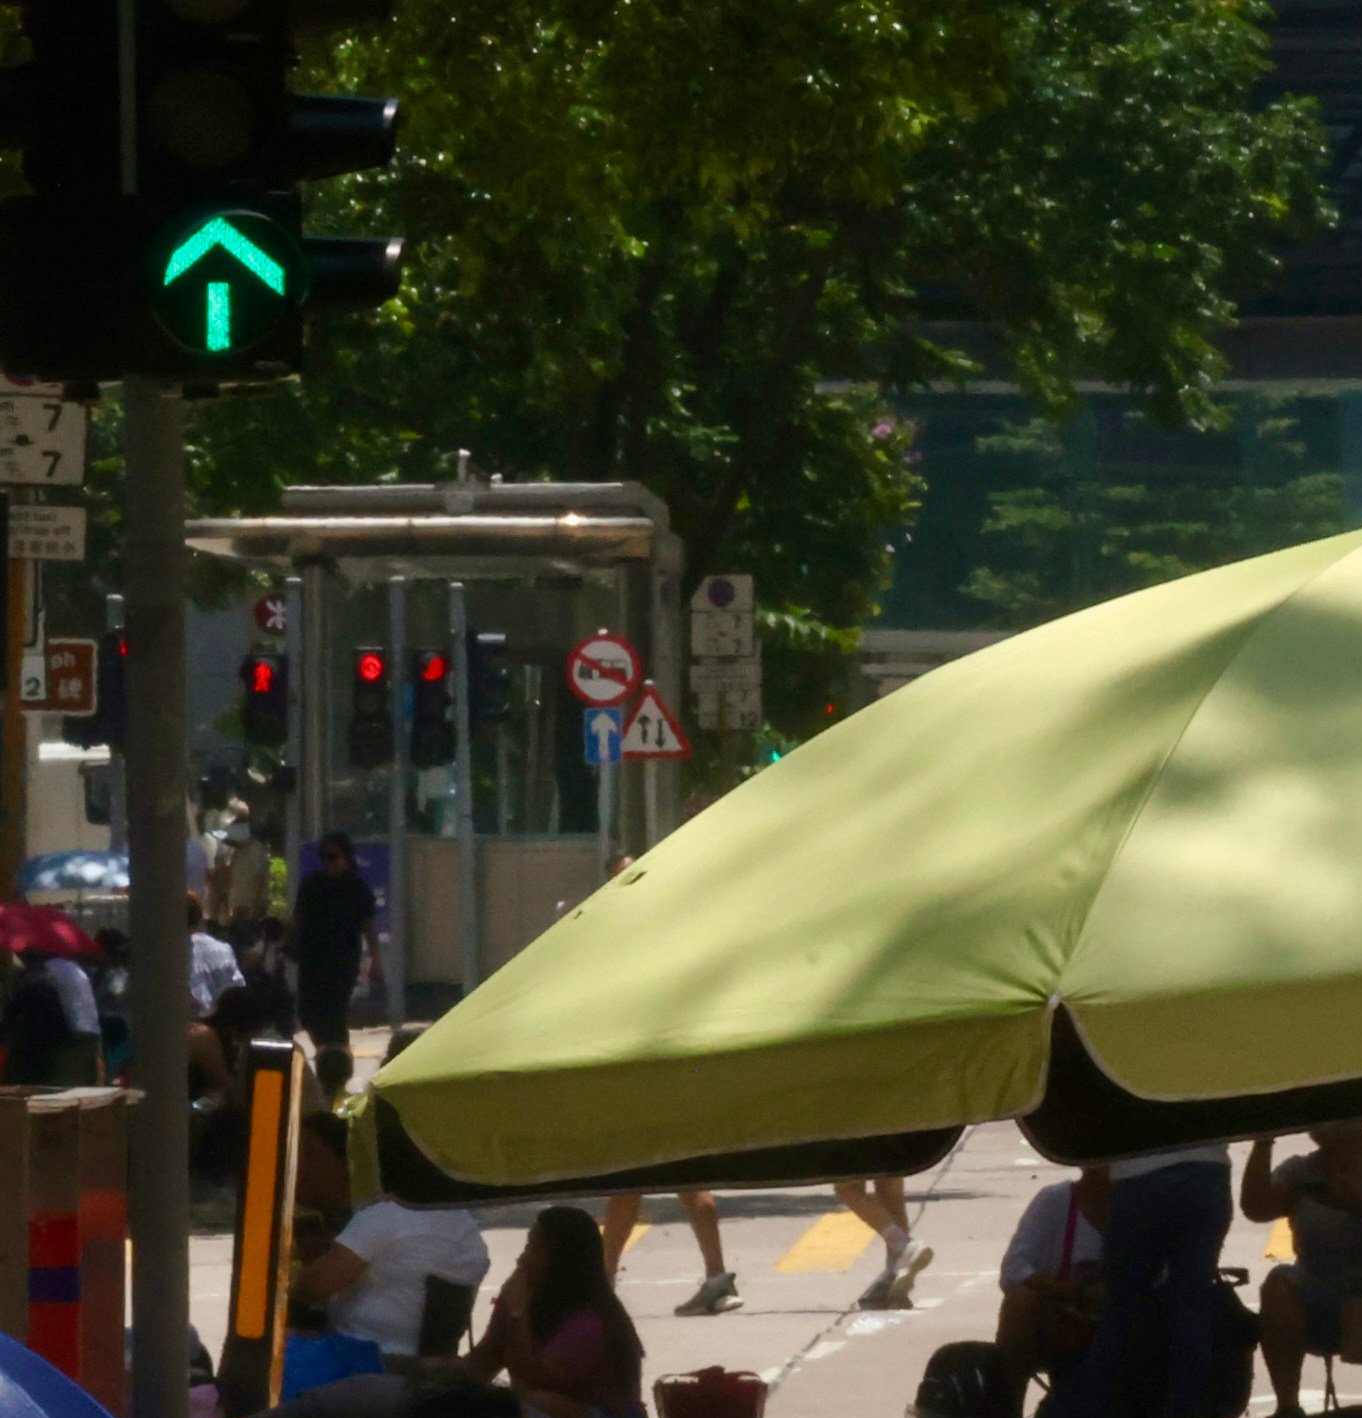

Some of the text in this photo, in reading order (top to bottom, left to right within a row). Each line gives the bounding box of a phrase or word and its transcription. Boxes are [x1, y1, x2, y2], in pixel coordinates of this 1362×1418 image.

[43, 403, 62, 431] 7
[42, 450, 62, 478] 7
[25, 676, 40, 697] 2
